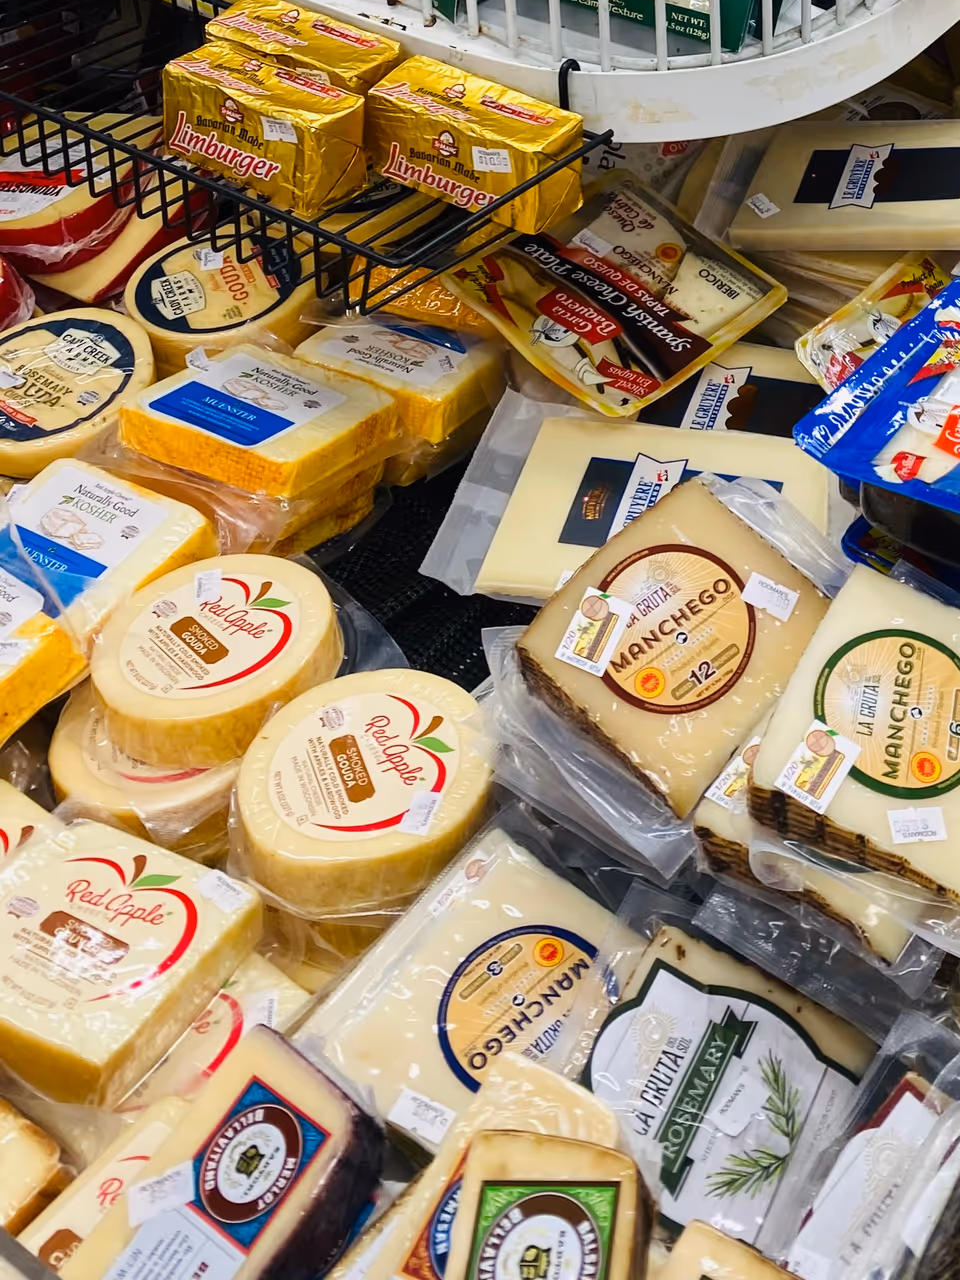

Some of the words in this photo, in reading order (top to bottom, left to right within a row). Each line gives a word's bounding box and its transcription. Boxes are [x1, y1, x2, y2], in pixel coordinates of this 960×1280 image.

[671, 11, 690, 23] NET
[691, 15, 707, 28] WT:
[169, 111, 281, 182] Limburger
[196, 115, 236, 135] Bavarian
[237, 129, 264, 151] Made
[381, 143, 501, 209] Limburger
[409, 148, 450, 168] Bavarian
[452, 161, 481, 185] Made
[524, 242, 571, 274] Plate
[612, 245, 680, 297] MANCHEGO
[161, 277, 175, 301] CREEK
[575, 272, 627, 311] Cheese
[698, 268, 741, 300] IBERICO
[168, 301, 183, 317] CADY
[555, 293, 617, 336] Baquero
[626, 303, 692, 353] Spanish
[348, 347, 375, 362] Good
[364, 345, 409, 364] KOSHER
[374, 354, 414, 375] Naturally
[250, 366, 293, 388] Naturally
[291, 380, 318, 397] Good
[252, 376, 301, 398] KOSHER
[202, 395, 258, 422] MUENSTER
[72, 498, 117, 524] KOSHER
[74, 484, 113, 508] Naturally
[113, 500, 140, 519] Good
[188, 624, 220, 651] SMOKED
[610, 578, 732, 675] MANCHEGO
[181, 632, 210, 657] GOUDA
[688, 660, 717, 689] 12
[859, 682, 880, 720] GRUTA
[881, 642, 918, 781] MANCHEGO
[364, 715, 400, 747] Red
[857, 722, 874, 738] LA
[336, 753, 357, 789] GOUDA
[346, 747, 369, 787] SMOKED
[376, 744, 424, 786] Apple
[65, 879, 112, 908] Red
[105, 893, 166, 928] Apple
[468, 958, 592, 1072] MANCHEGO
[679, 1035, 693, 1056] SOL
[634, 1106, 657, 1136] LA
[651, 1049, 687, 1108] GRUTA
[660, 1032, 728, 1162] ROSEMARY
[256, 1157, 297, 1211] MERLOT
